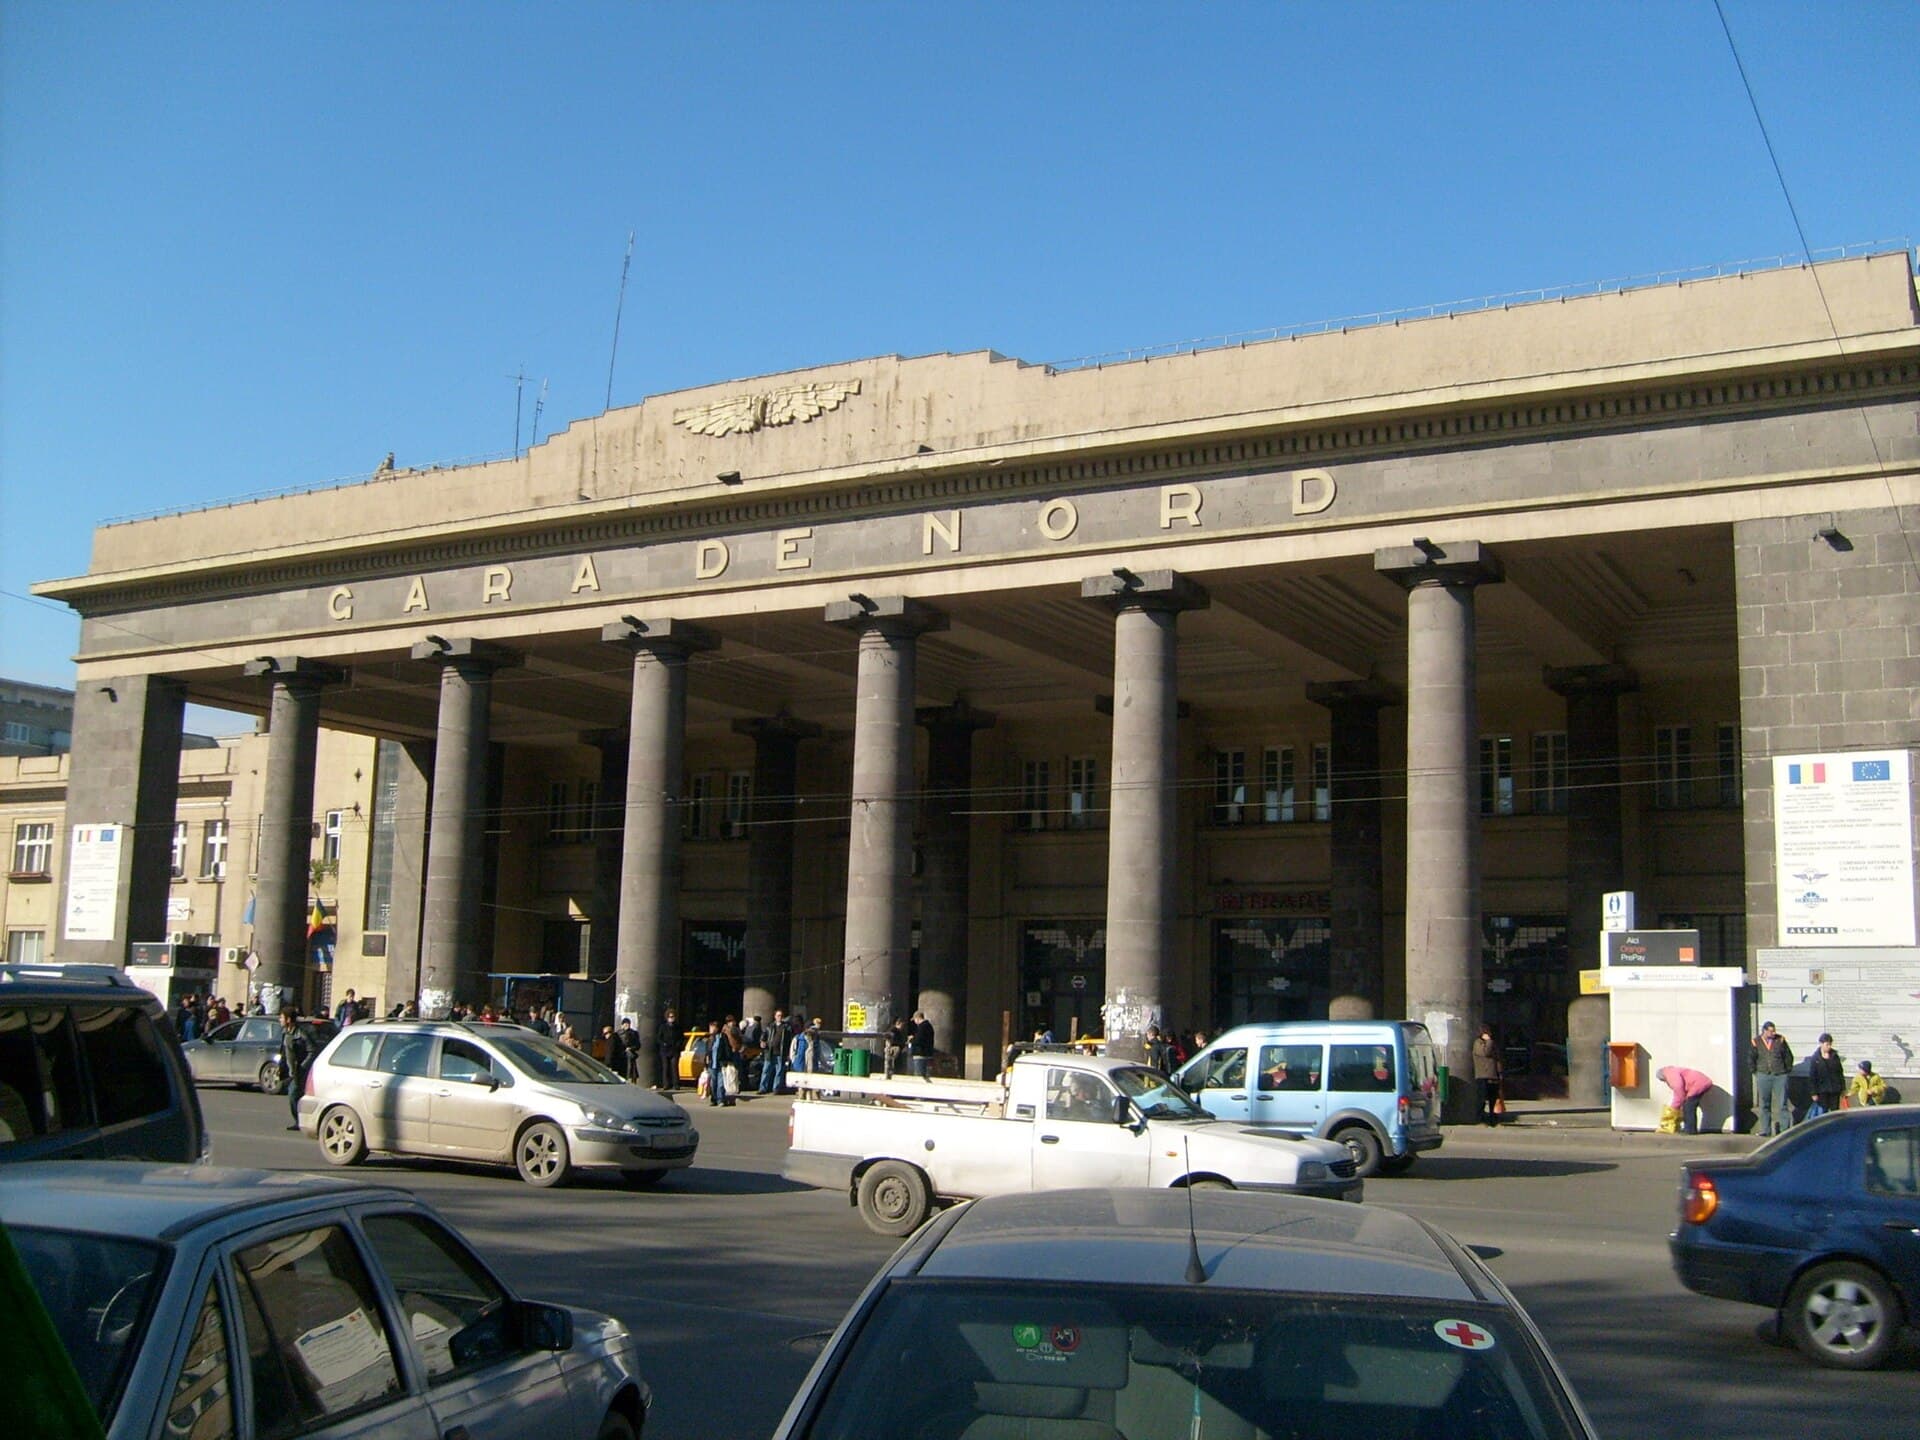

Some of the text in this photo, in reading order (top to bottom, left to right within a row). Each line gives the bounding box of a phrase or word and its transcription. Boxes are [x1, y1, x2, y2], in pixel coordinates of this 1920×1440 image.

[328, 468, 1338, 621] GARA DE NORD
